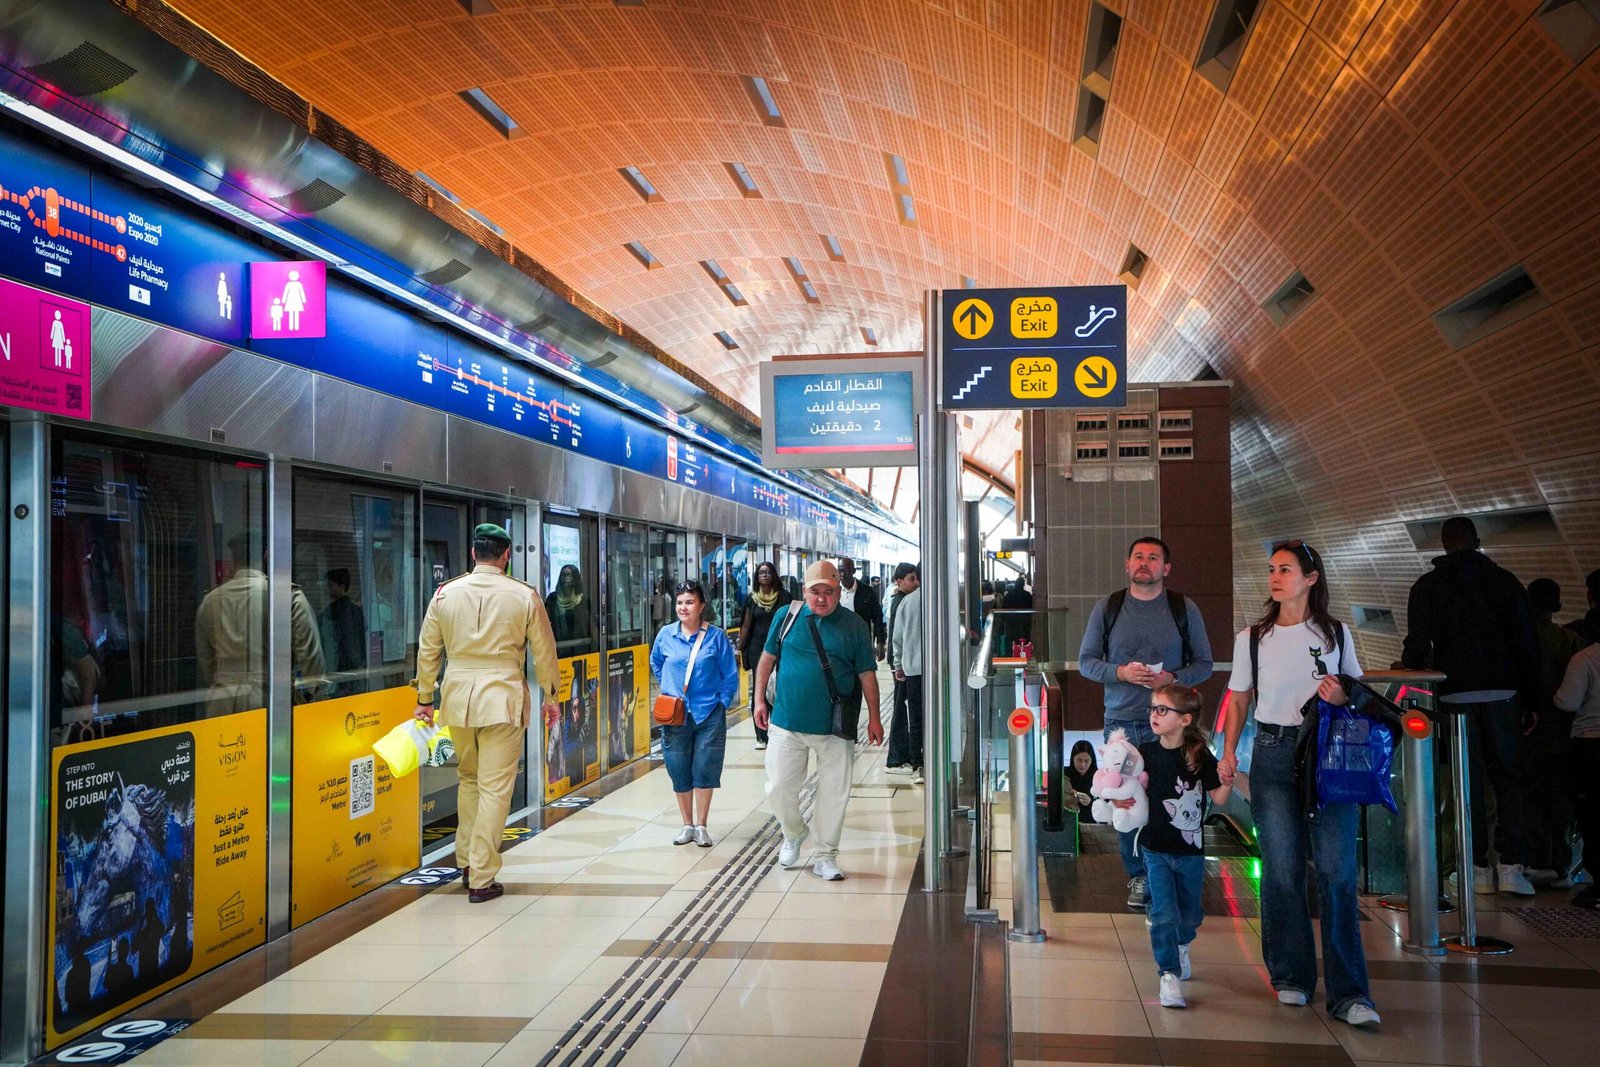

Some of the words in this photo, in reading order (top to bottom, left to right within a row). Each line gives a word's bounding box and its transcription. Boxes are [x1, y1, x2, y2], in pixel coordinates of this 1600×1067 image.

[47, 206, 57, 219] 38
[128, 212, 143, 226] 2020
[10, 222, 21, 233] City
[117, 219, 124, 230] 76
[128, 226, 143, 240] Expo
[144, 232, 159, 246] 2020
[35, 246, 55, 260] National
[56, 253, 70, 264] Paints
[117, 248, 125, 260] 42
[143, 258, 164, 274] صيدلية
[129, 266, 140, 278] Life
[140, 271, 168, 291] Pharmacy
[1017, 300, 1052, 315] مخرج
[1021, 319, 1048, 331] Exit
[1017, 361, 1052, 375] مخرج
[804, 380, 840, 394] القادم
[844, 378, 882, 394] القطار
[1021, 380, 1048, 392] Exit
[806, 400, 834, 415] لايف
[837, 400, 881, 413] صيدلية
[810, 421, 862, 435] دقيقتين
[874, 420, 881, 430] 2
[176, 752, 190, 765] قصة
[66, 766, 80, 775] STEP
[82, 762, 95, 772] INTO
[161, 758, 174, 774] دبي
[66, 778, 84, 792] THE
[85, 771, 114, 787] STORY
[167, 770, 180, 785] قرب
[181, 770, 190, 782] عن
[66, 796, 78, 809] OF
[80, 790, 107, 806] DUBAI
[215, 814, 226, 824] رحلة
[238, 806, 248, 819] على
[219, 825, 232, 837] فقط
[233, 823, 244, 834] مترو
[213, 842, 226, 854] Just
[232, 835, 250, 846] Metro
[216, 855, 229, 867] Ride
[231, 850, 247, 861] Away
